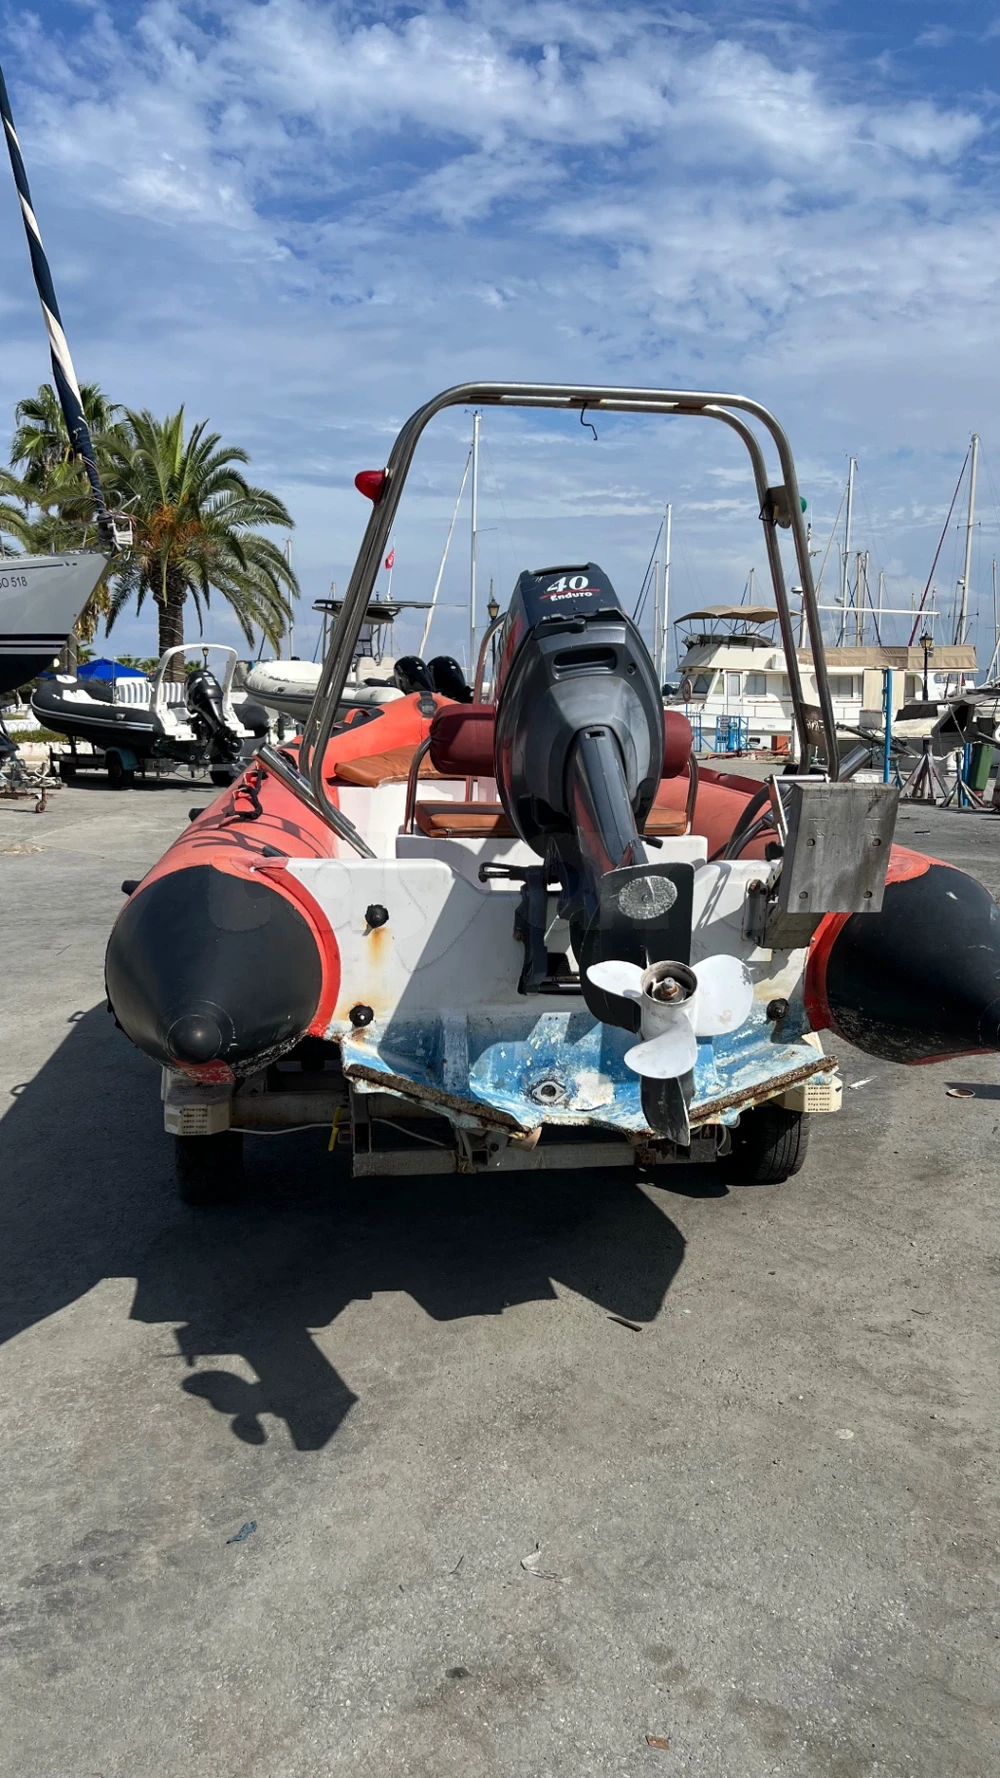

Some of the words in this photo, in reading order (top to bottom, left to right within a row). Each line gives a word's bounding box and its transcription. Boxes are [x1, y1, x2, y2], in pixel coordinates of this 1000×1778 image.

[11, 576, 28, 588] 518
[546, 575, 589, 593] 40
[549, 591, 593, 602] Enduro
